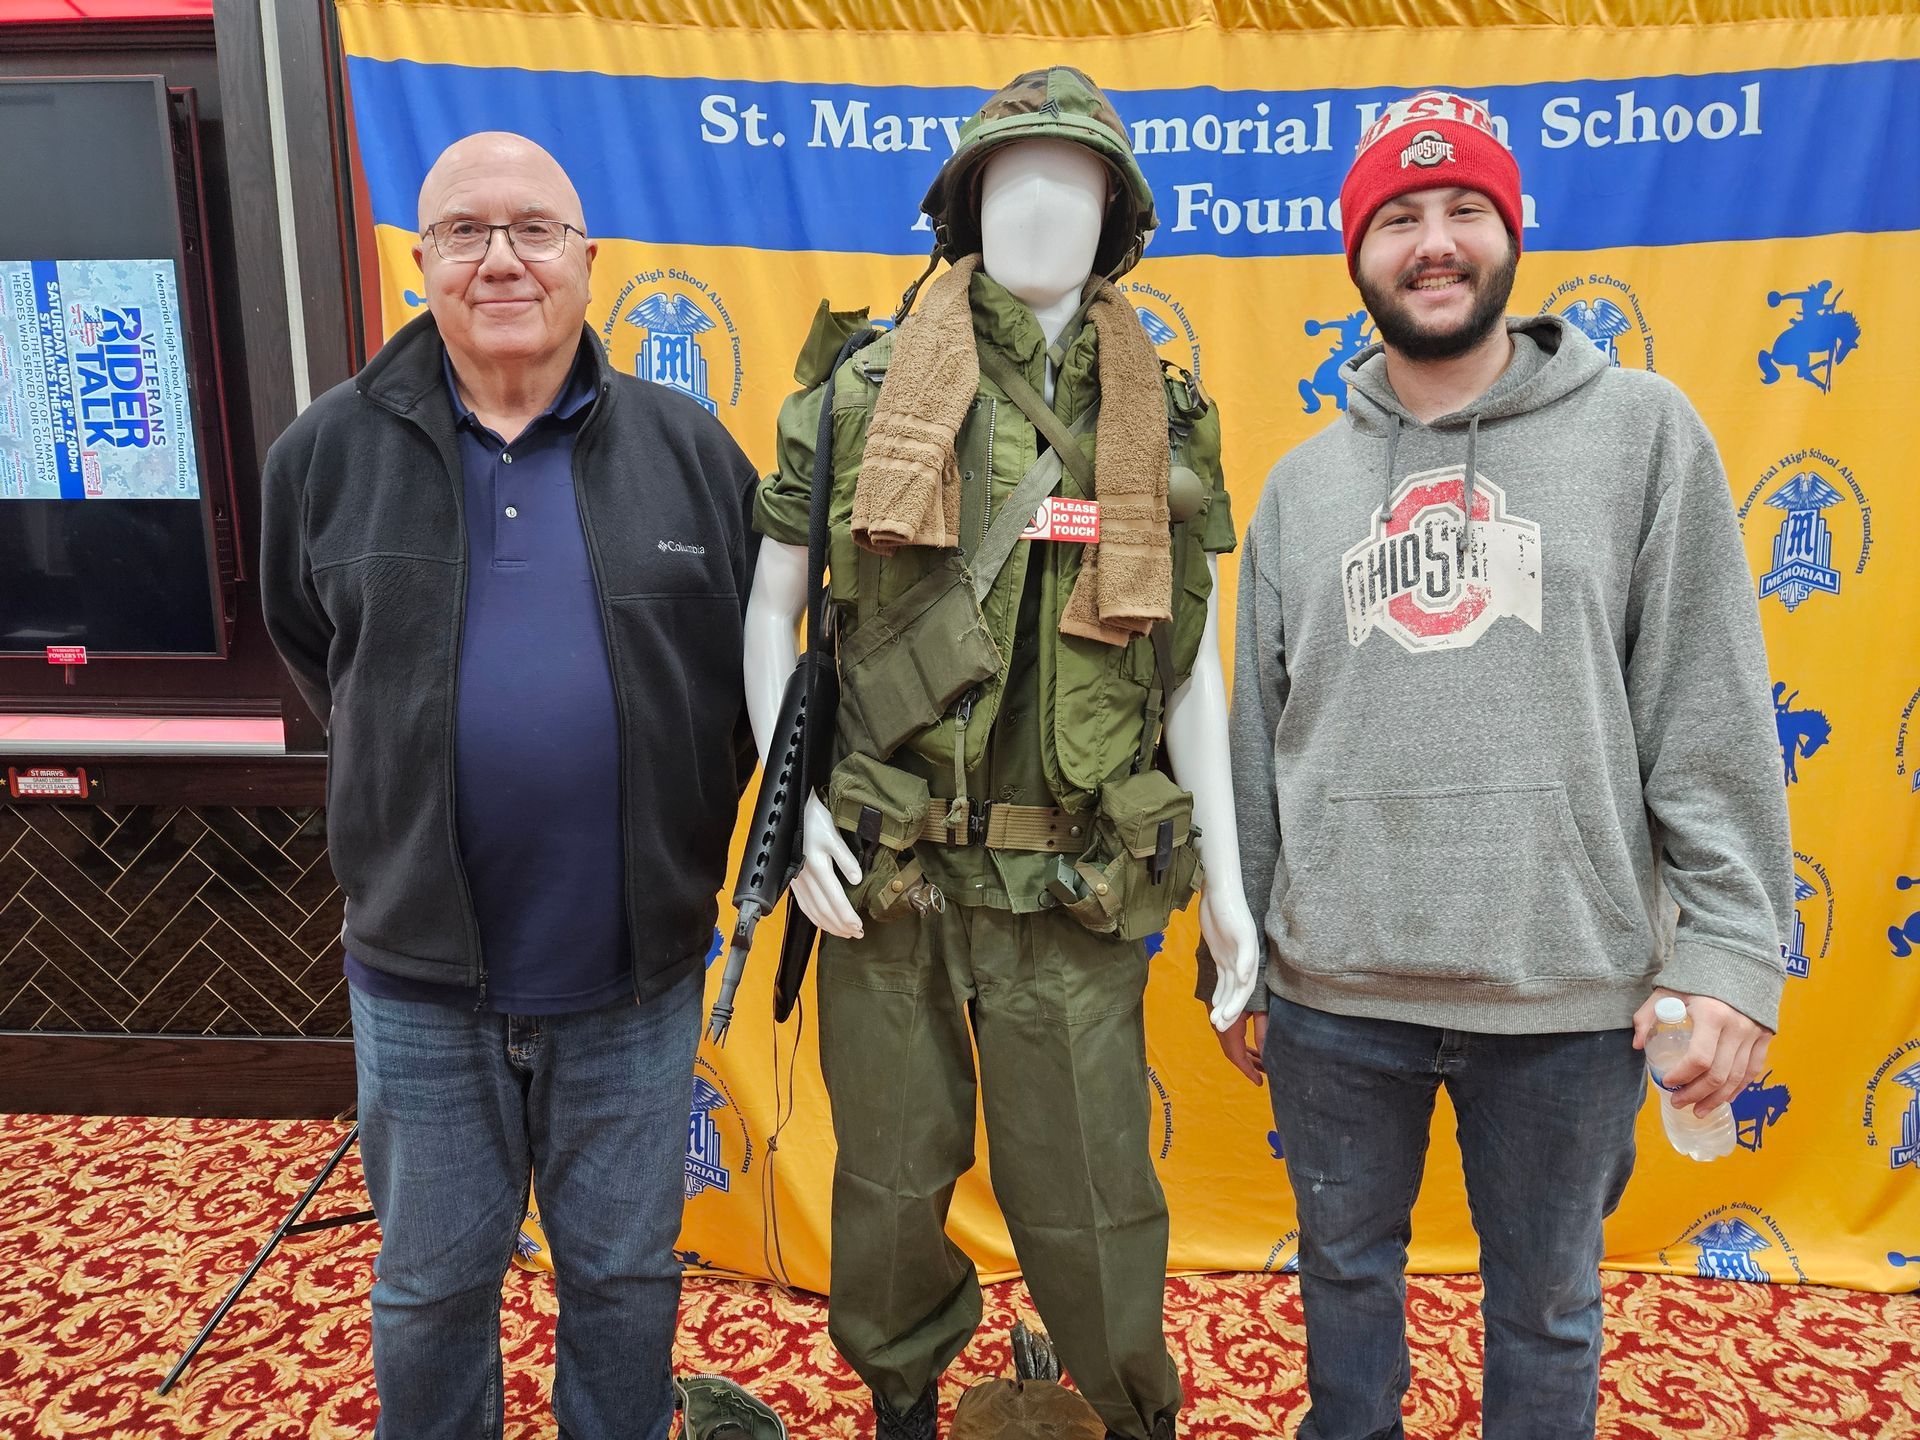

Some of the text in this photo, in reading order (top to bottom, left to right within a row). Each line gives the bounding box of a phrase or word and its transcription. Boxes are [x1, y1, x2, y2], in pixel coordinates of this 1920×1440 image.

[700, 95, 787, 148] St.
[806, 99, 972, 165] Mary
[1130, 100, 1333, 155] morial
[1541, 81, 1763, 150] School
[22, 272, 38, 334] HONORING
[1131, 281, 1199, 343] School Alumni
[1537, 273, 1657, 373] orial High School Alumni Found
[31, 335, 41, 358] THE
[603, 268, 744, 407] Memorial High School Alumni Foundation
[12, 274, 48, 481] HEROES WHO SERVED OUR COUNTRY
[15, 367, 25, 399] featuring
[33, 359, 48, 405] HISTORY
[40, 312, 66, 443] ST. MARYS THEATER
[47, 281, 80, 473] SATURDAY, NOV. 8th 7:00PM
[76, 344, 116, 448] TALK
[98, 307, 151, 449] RIDER
[141, 332, 166, 446] VETERANS
[155, 273, 188, 490] Memorial High School Alumni Foundation
[161, 367, 172, 400] presents
[40, 409, 49, 426] OF
[41, 426, 51, 442] ST.
[1052, 502, 1097, 514] PLEASE
[1052, 513, 1097, 525] DO NOT
[1053, 525, 1096, 537] TOUCH
[1737, 448, 1874, 575] Memorial High School Alumni Foundation
[667, 540, 705, 554] Columbia
[1765, 564, 1835, 591] MEMORIAL
[1895, 721, 1908, 757] Marys
[1896, 759, 1906, 776] St.
[1793, 850, 1835, 959] ool Alumni Foundation
[1866, 1047, 1905, 1092] Memorial
[694, 1056, 754, 1174] chool Alumni Foundation
[1160, 1101, 1174, 1160] Foundation
[1863, 1094, 1876, 1129] Marys
[1867, 1130, 1878, 1147] St.
[685, 1160, 724, 1185] ORIAL
[1702, 1204, 1728, 1219] High
[1730, 1201, 1763, 1216] School
[1761, 1214, 1795, 1253] Alumni
[1263, 1238, 1287, 1273] morial
